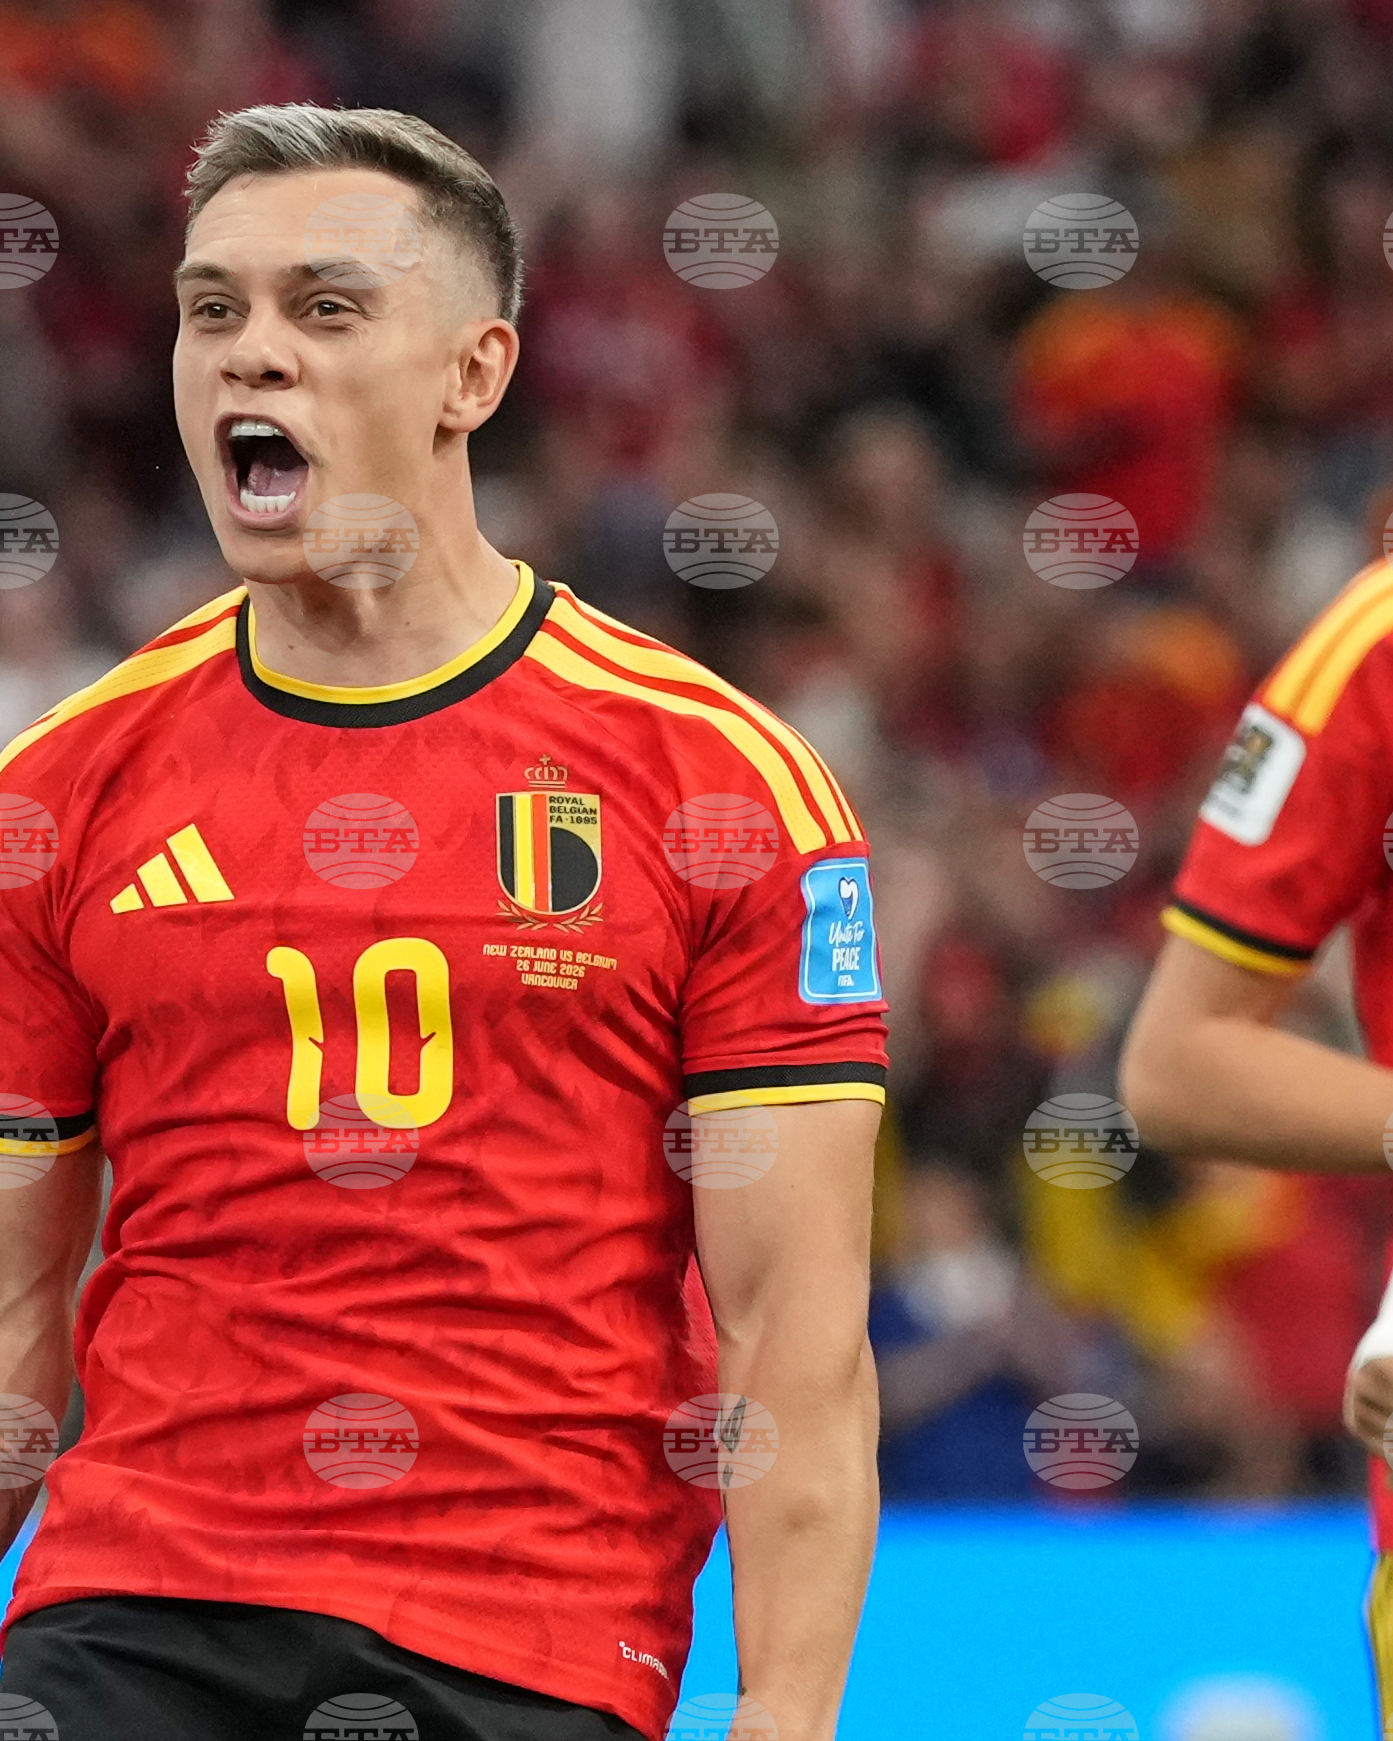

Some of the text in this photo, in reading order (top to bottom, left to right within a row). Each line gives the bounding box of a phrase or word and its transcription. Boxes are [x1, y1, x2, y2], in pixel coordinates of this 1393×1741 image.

[549, 796, 585, 805] ROYAL
[549, 805, 597, 815] BELGIAN
[483, 944, 618, 971] NEW ZEALAND VS BELGIUM
[832, 946, 861, 971] PEACE
[516, 959, 586, 978] 26 JUNE 2026
[521, 972, 578, 991] VANCOUVER
[266, 937, 454, 1131] 10
